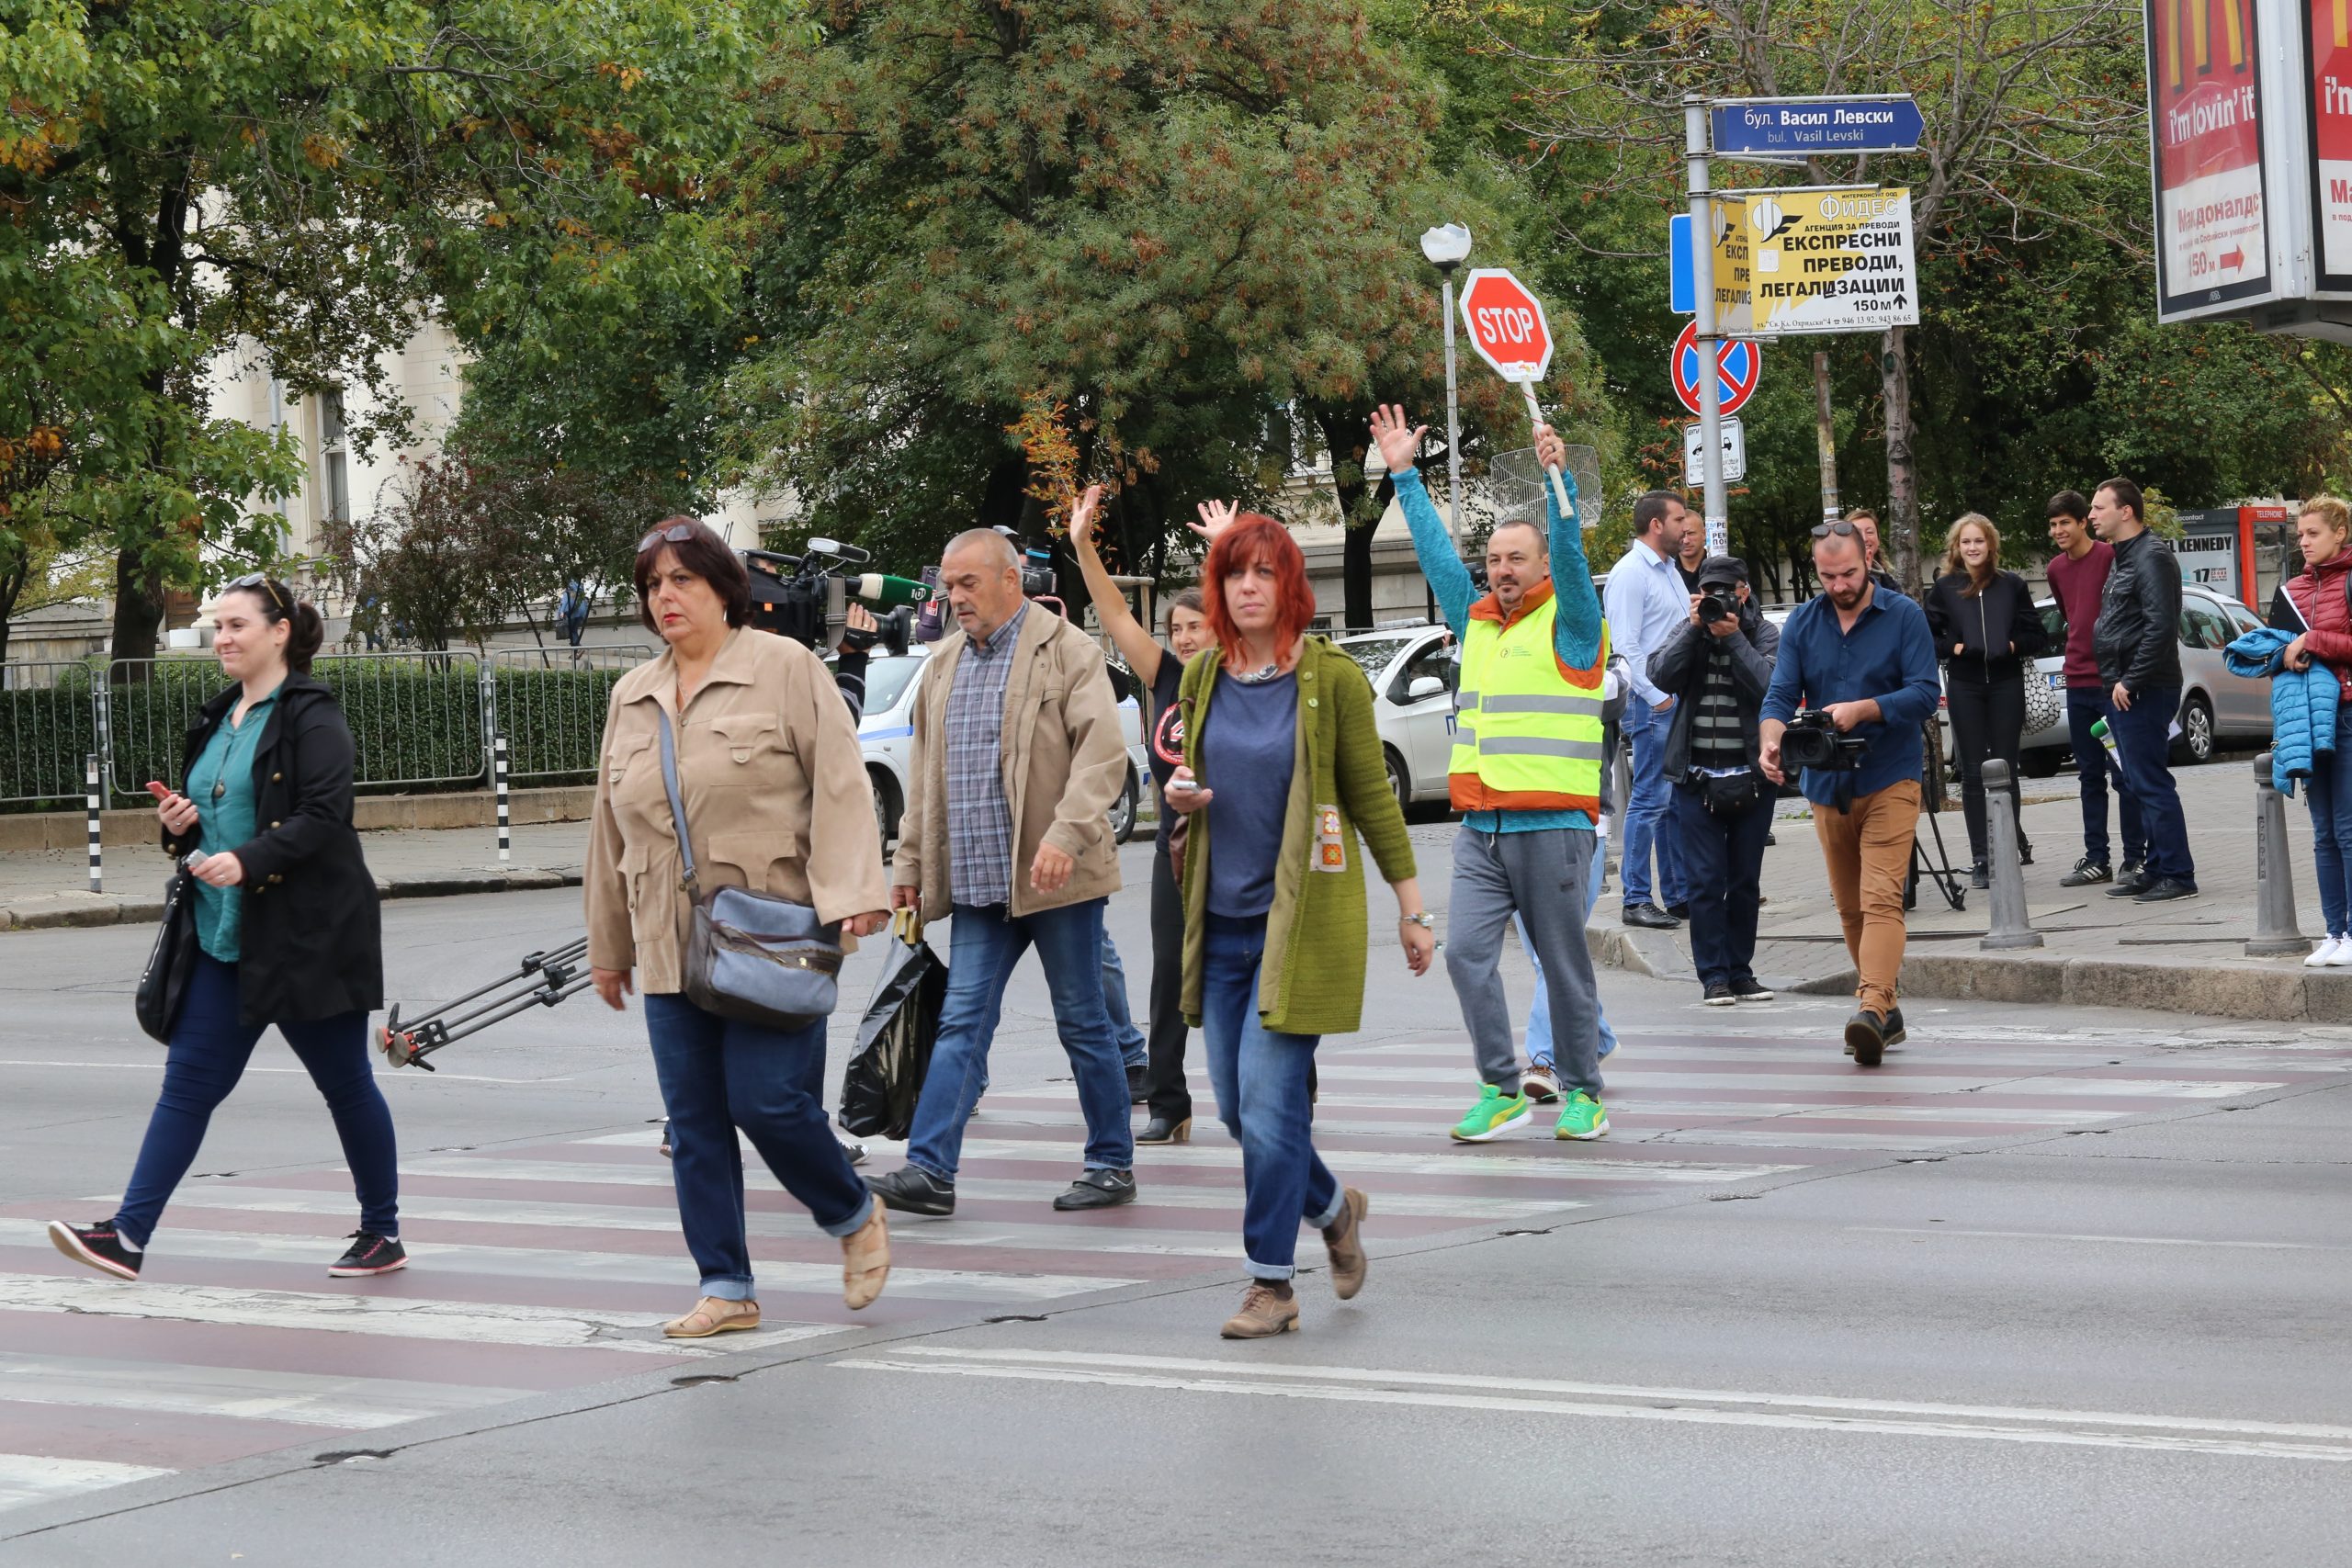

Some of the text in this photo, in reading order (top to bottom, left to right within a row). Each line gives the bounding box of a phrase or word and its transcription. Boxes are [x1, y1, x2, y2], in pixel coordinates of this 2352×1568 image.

[1745, 109, 1894, 129] бул. Васил Левски
[2169, 109, 2190, 144] i'm
[2192, 88, 2238, 137] lovin'
[1768, 129, 1864, 143] bul. Vasil Levski
[1804, 224, 1843, 232] АГЕНЦИЯ
[1860, 221, 1900, 230] ПРЕВОДИ
[1783, 232, 1902, 252] ЕКСПРЕСНИ
[1804, 254, 1904, 273] ПРЕВОДИ,
[1759, 277, 1905, 299] ЛЕГАЛИЗАЦИИ
[1853, 299, 1879, 311] 150
[1477, 307, 1534, 344] STOP
[1841, 316, 1855, 324] 946
[1893, 314, 1902, 322] 86
[1903, 314, 1912, 322] 65
[2256, 510, 2284, 519] TELEPHONE
[2178, 536, 2233, 553] KENNEDY
[2193, 568, 2211, 583] 17
